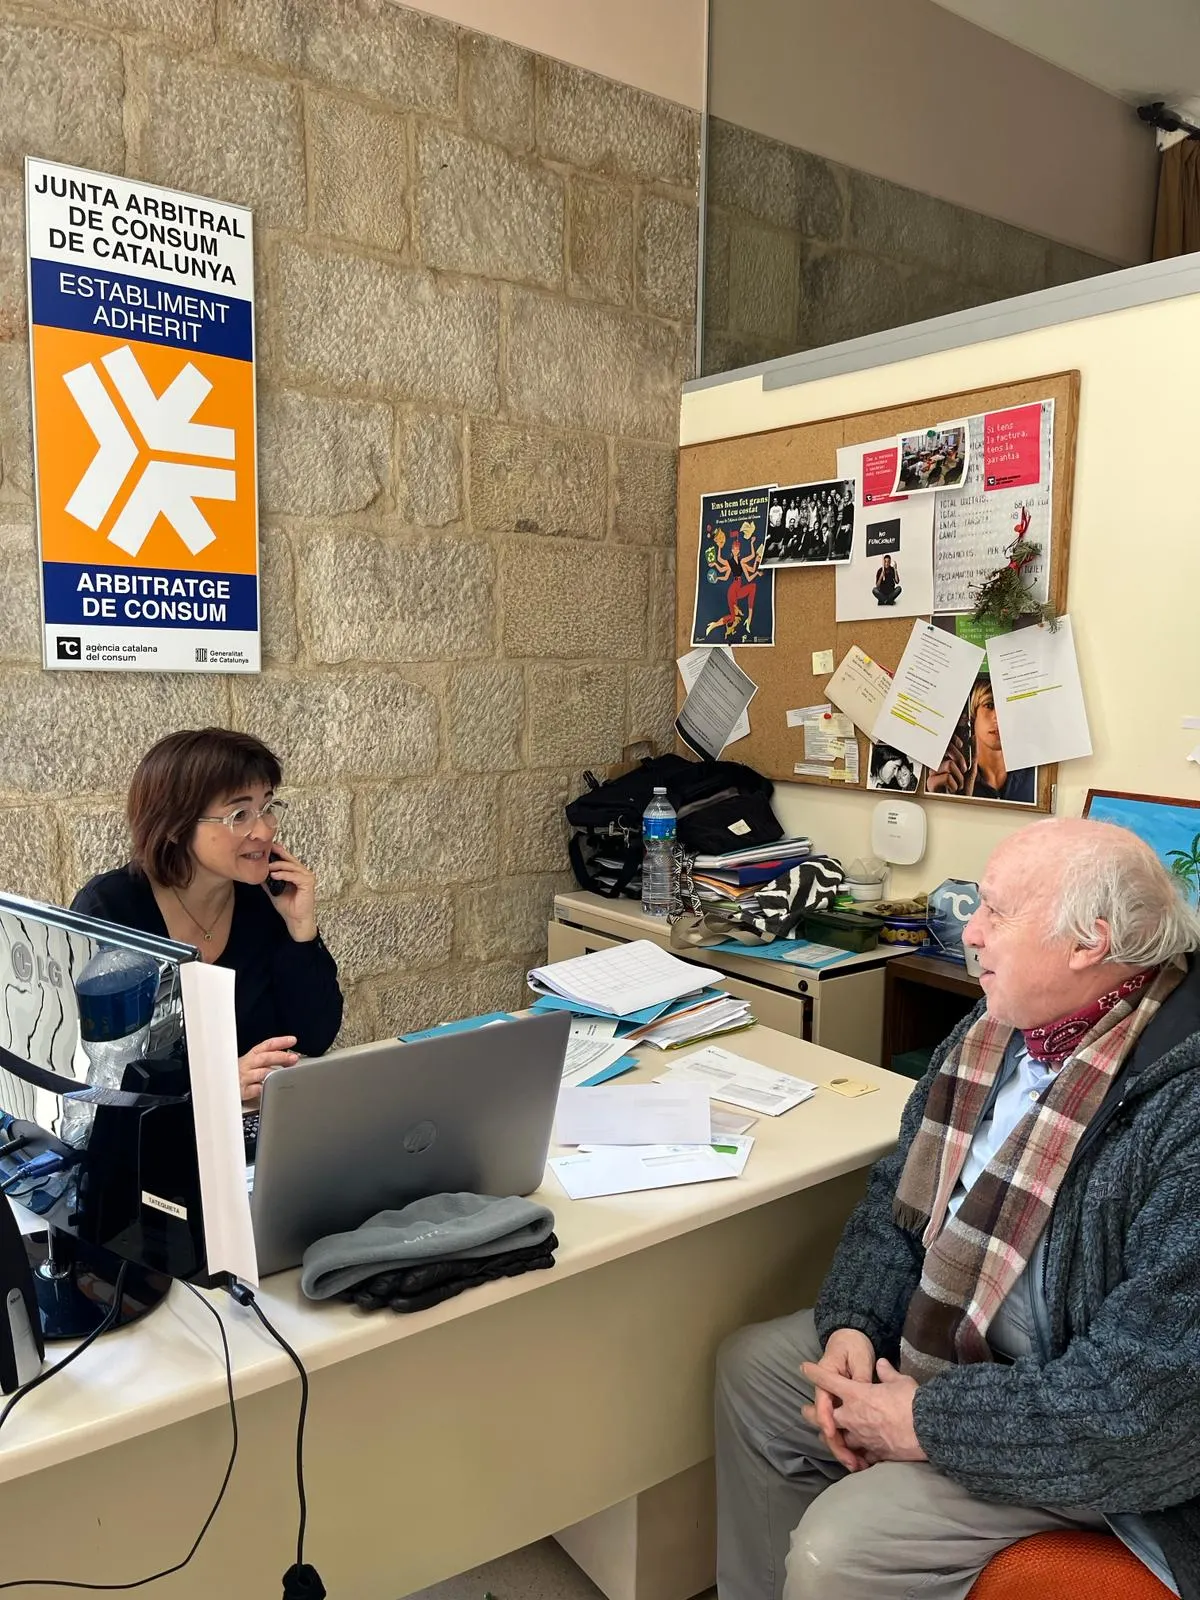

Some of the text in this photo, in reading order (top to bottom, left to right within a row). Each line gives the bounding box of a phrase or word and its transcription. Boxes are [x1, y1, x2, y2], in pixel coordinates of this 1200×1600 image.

[35, 174, 245, 239] JUNTA ARBITRAL
[69, 205, 218, 256] DE CONSUM
[49, 228, 237, 285] DE CATALUNYA
[59, 272, 229, 323] ESTABLIMENT
[93, 305, 202, 343] ADHERIT
[997, 422, 1014, 432] tens
[987, 445, 1003, 453] tens
[711, 502, 724, 510] Ens
[724, 501, 739, 509] hem
[76, 572, 231, 599] ARBITRATGE
[82, 597, 227, 622] DE CONSUM
[85, 643, 158, 654] agència catalana
[86, 653, 100, 661] del
[37, 955, 63, 988] LG
